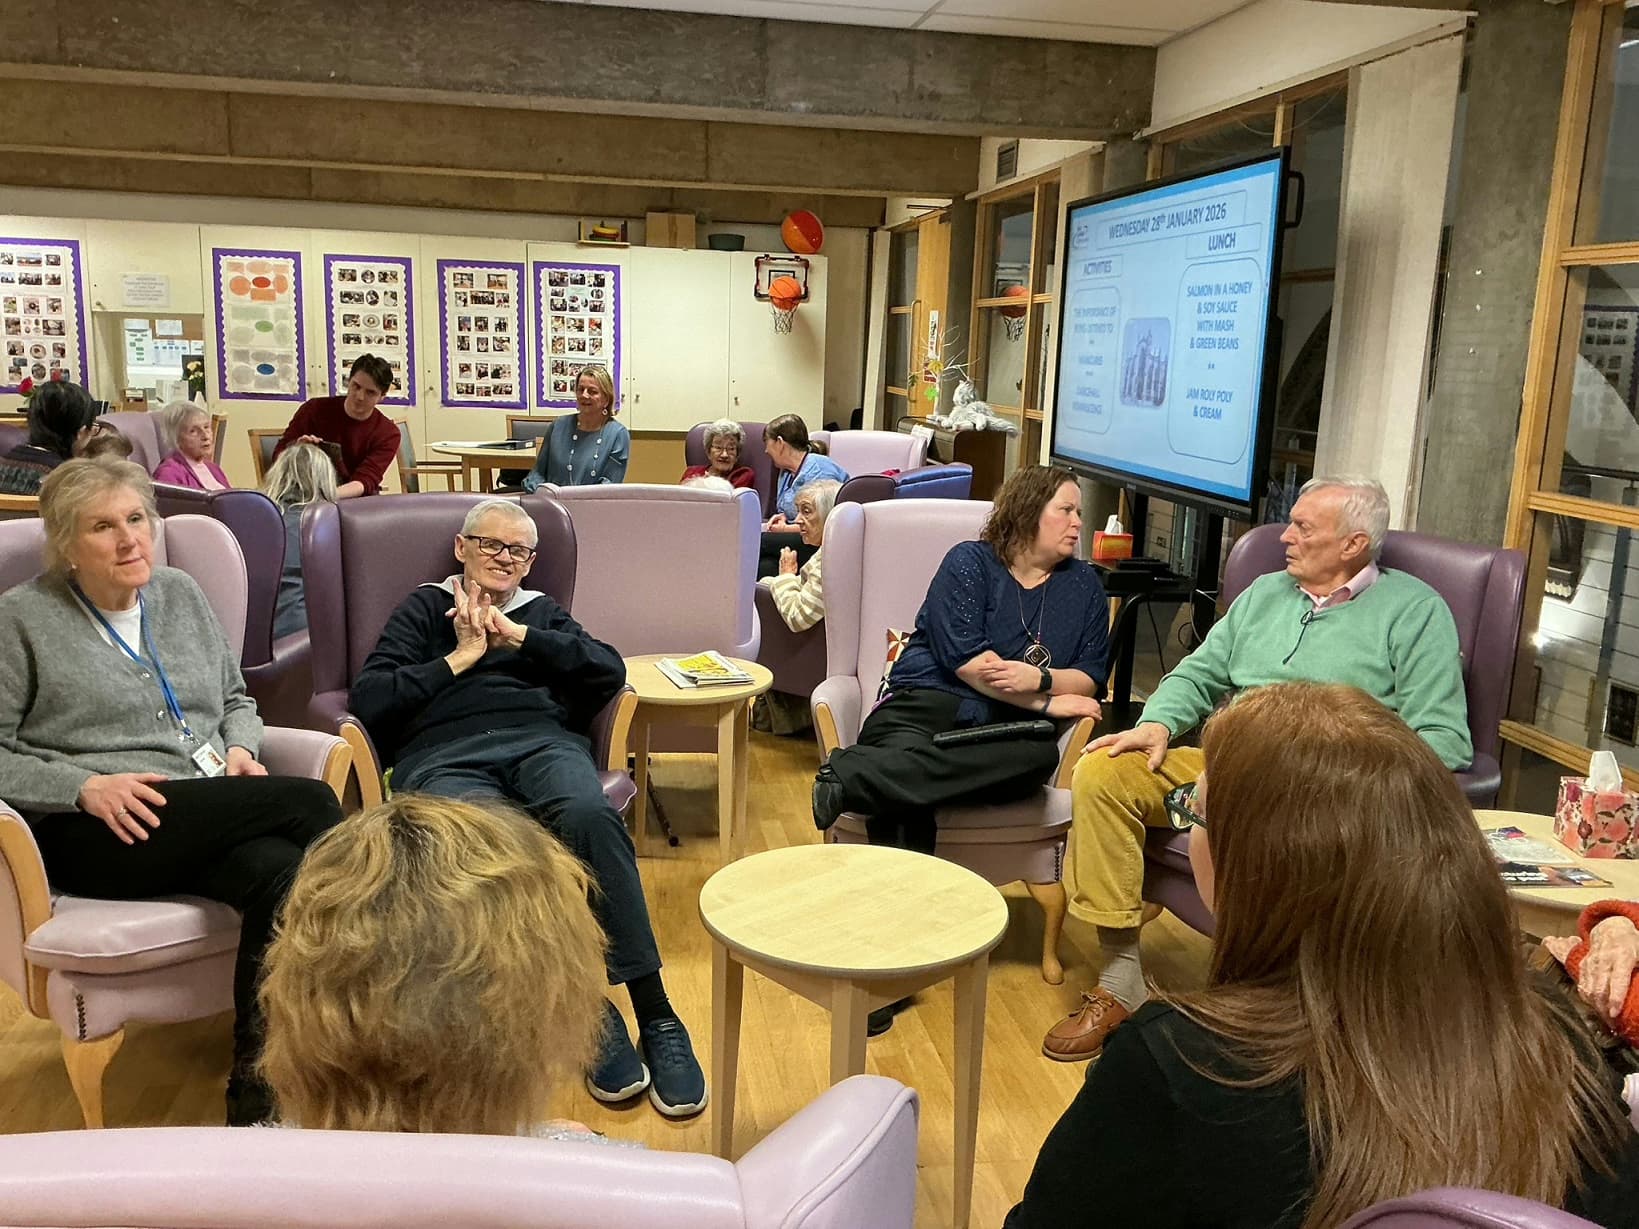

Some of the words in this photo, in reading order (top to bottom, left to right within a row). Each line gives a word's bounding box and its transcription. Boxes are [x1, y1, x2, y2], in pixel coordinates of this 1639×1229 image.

[1109, 219, 1150, 239] WEDNESDAY
[1166, 207, 1204, 229] JANUARY
[1205, 203, 1226, 221] 2026
[1208, 232, 1236, 250] LUNCH
[1083, 260, 1112, 275] ACTIVITIES
[1187, 284, 1213, 297] SALMON
[1215, 283, 1221, 296] IN
[1222, 282, 1228, 295] A
[1229, 281, 1253, 295] HONEY
[1203, 301, 1216, 314] SOY
[1216, 301, 1238, 313] SAUCE
[1197, 320, 1214, 332] WITH
[1215, 319, 1234, 332] MASH
[1196, 337, 1217, 349] GREEN
[1217, 337, 1239, 350] BEANS
[1186, 388, 1199, 400] JAM
[1200, 388, 1217, 401] ROLY
[1216, 390, 1233, 403] POLY
[1200, 406, 1222, 420] CREAM
